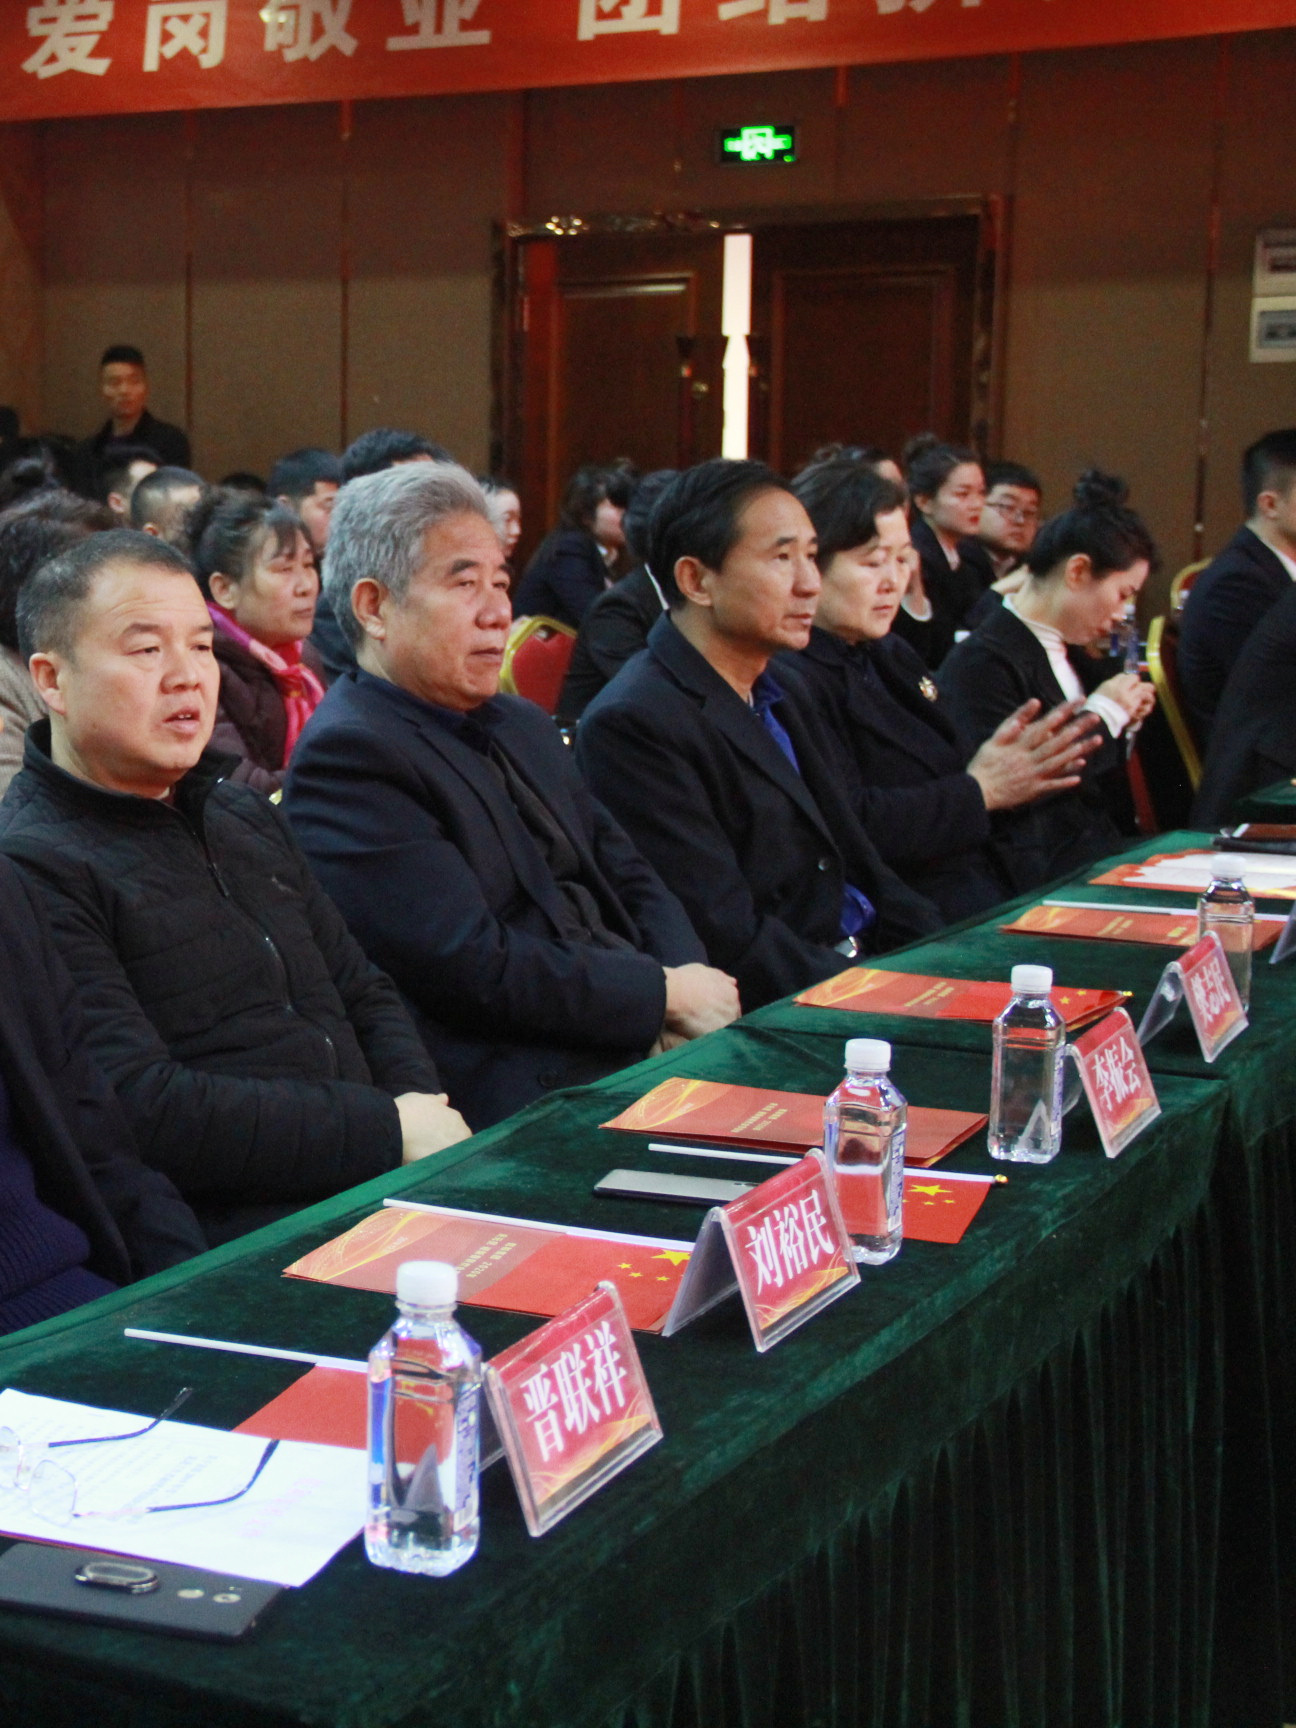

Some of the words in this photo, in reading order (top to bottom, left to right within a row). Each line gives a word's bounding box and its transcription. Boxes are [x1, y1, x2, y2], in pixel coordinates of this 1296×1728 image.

[745, 1189, 835, 1296] 刘裕民
[520, 1321, 627, 1462] 晋联祥
